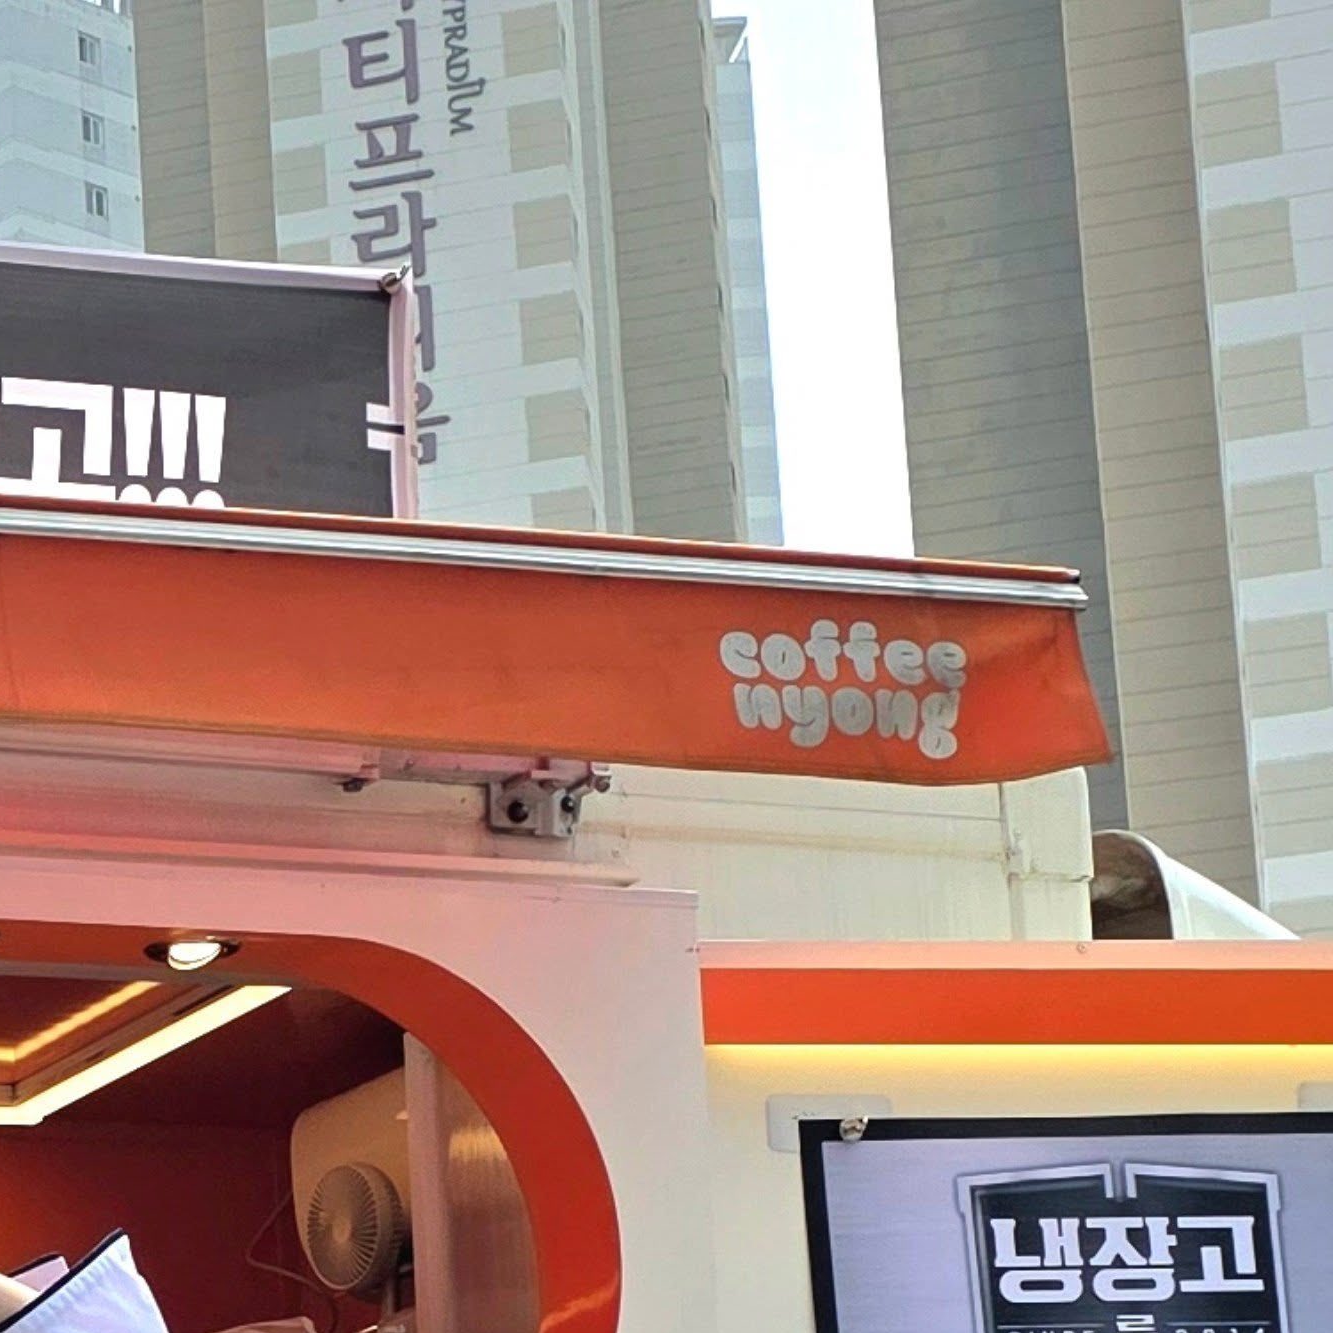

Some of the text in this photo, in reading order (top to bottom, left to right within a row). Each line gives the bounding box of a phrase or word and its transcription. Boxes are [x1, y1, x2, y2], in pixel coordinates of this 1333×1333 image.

[720, 619, 967, 687] coffee
[733, 682, 960, 759] nyong
[989, 1214, 1266, 1305] 냉장고
